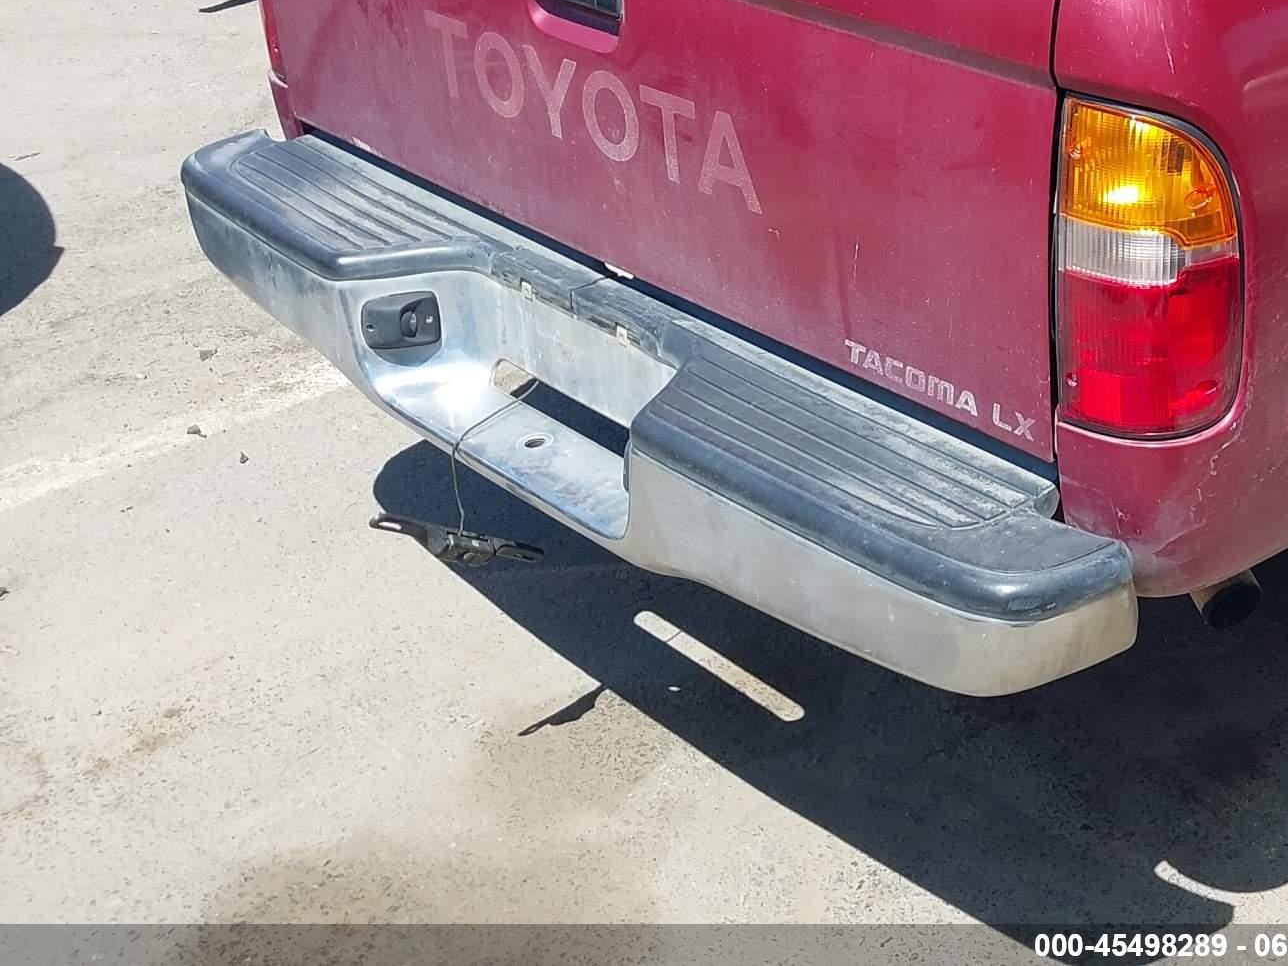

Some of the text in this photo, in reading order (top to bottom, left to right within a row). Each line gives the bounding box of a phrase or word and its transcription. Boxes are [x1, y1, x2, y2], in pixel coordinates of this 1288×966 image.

[424, 9, 763, 215] TOYOTA
[844, 339, 1036, 442] TACOMA LX
